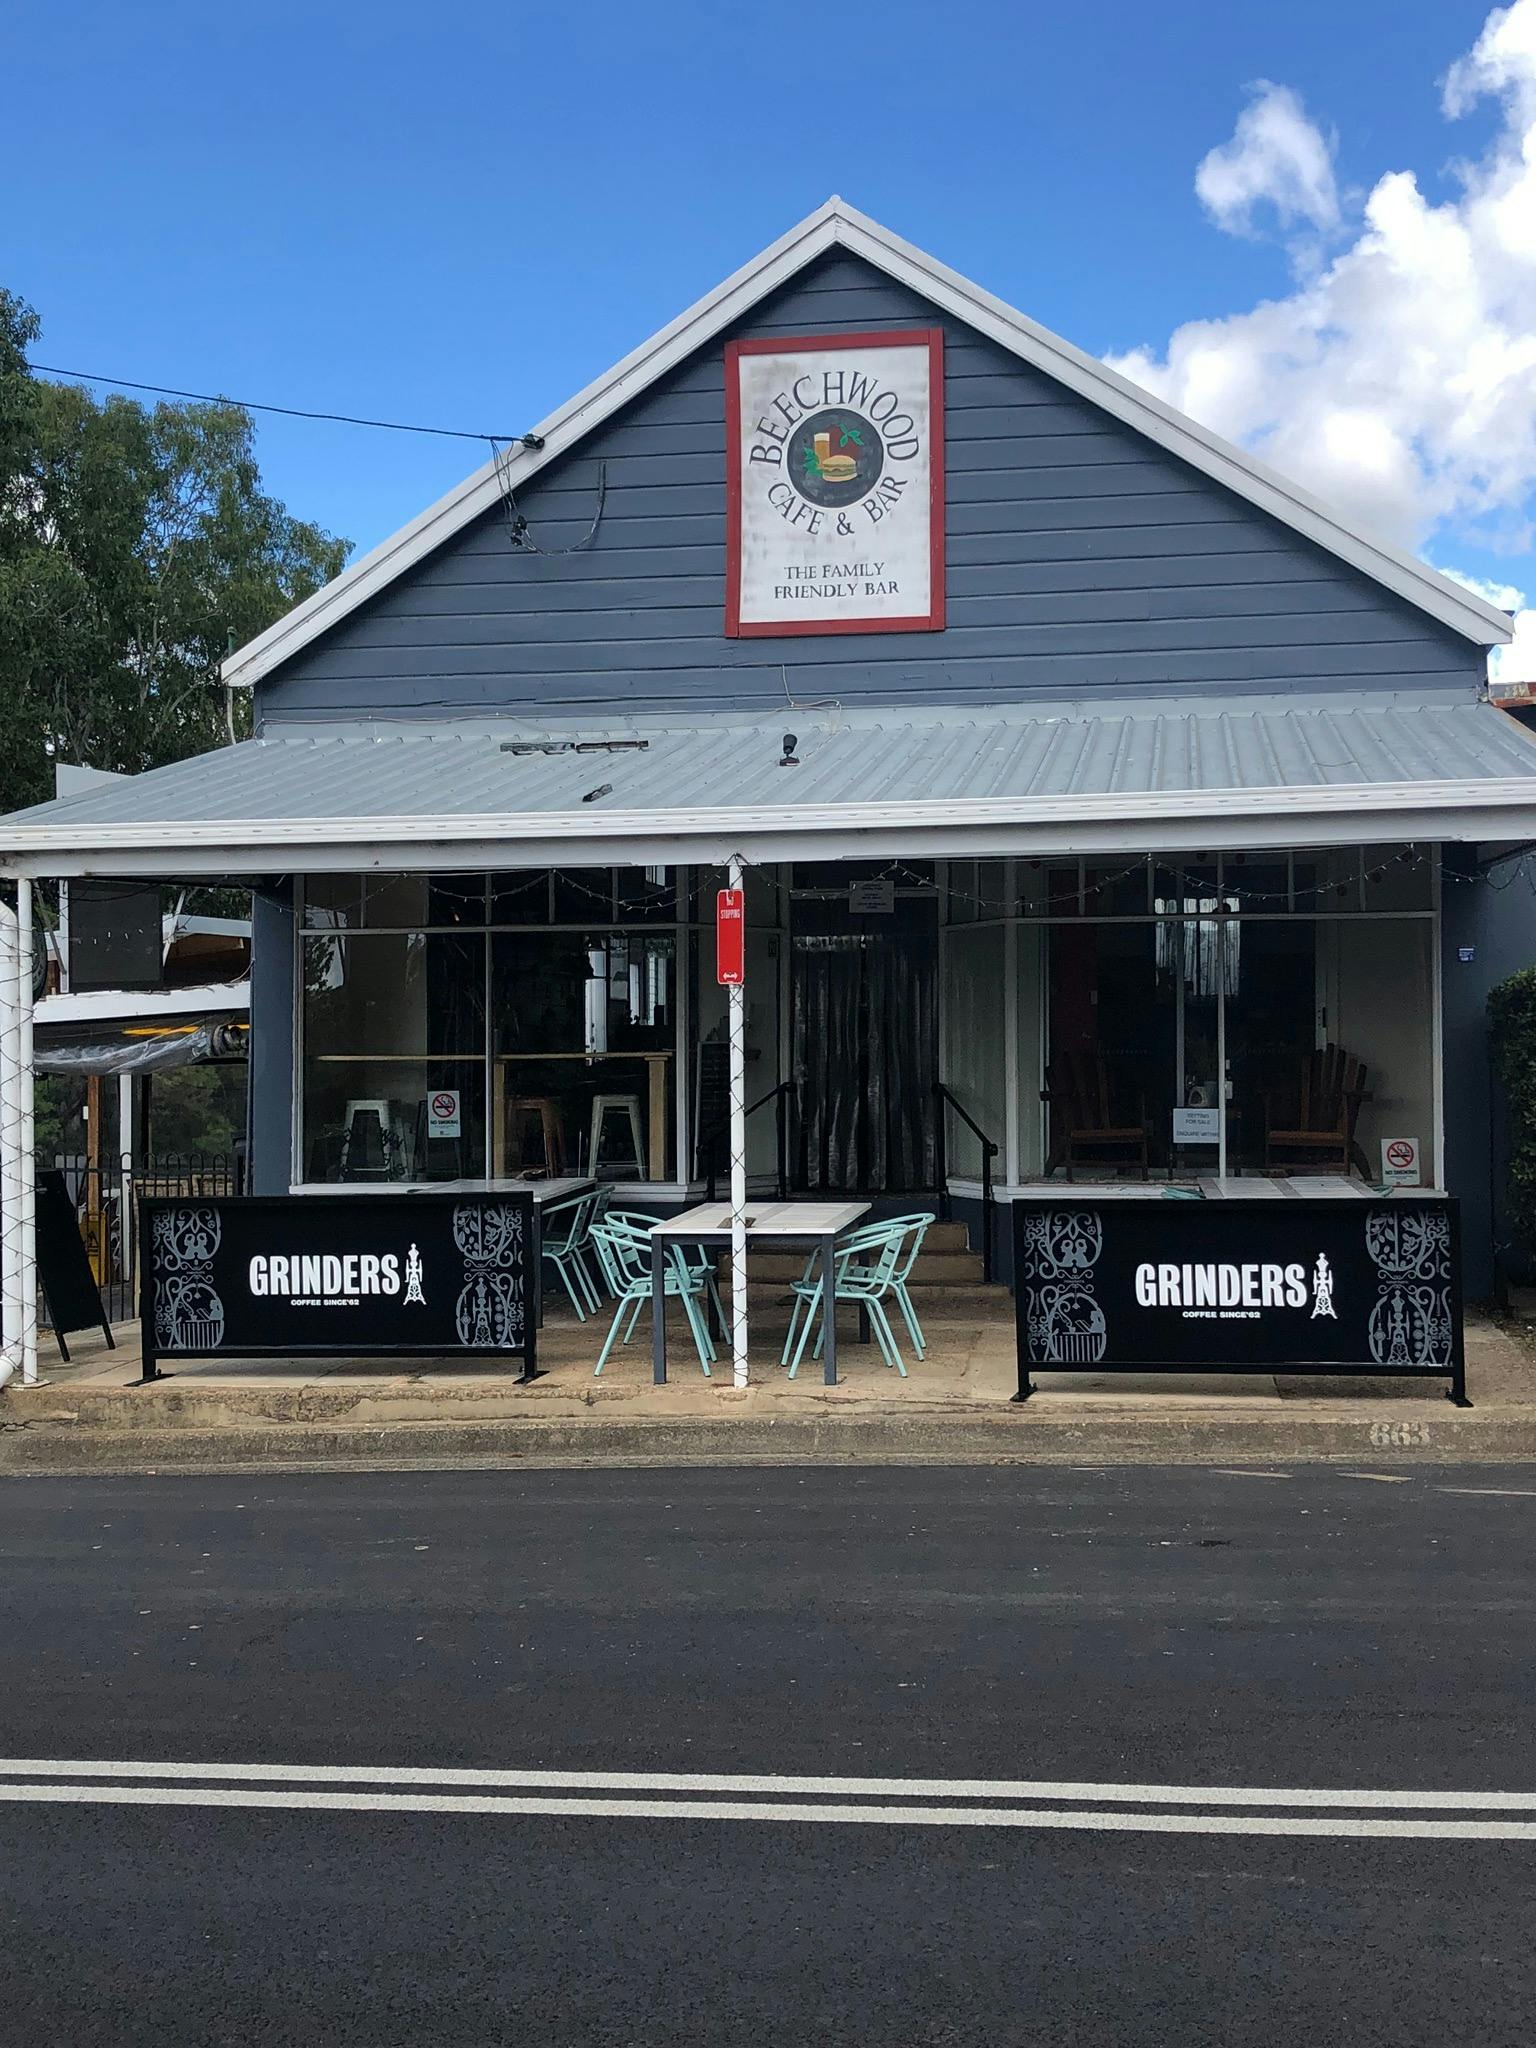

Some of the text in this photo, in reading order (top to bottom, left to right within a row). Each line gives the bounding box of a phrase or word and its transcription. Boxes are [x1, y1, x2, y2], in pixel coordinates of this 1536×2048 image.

[749, 371, 919, 468] BEECHWOOD
[836, 512, 854, 536] &
[861, 476, 908, 523] BAR
[774, 581, 899, 599] FRIENDLY BAR
[784, 562, 885, 580] THE FAMILY
[720, 909, 740, 919] STOPPING
[249, 1254, 401, 1296] GRINDERS
[1135, 1263, 1308, 1308] GRINDERS
